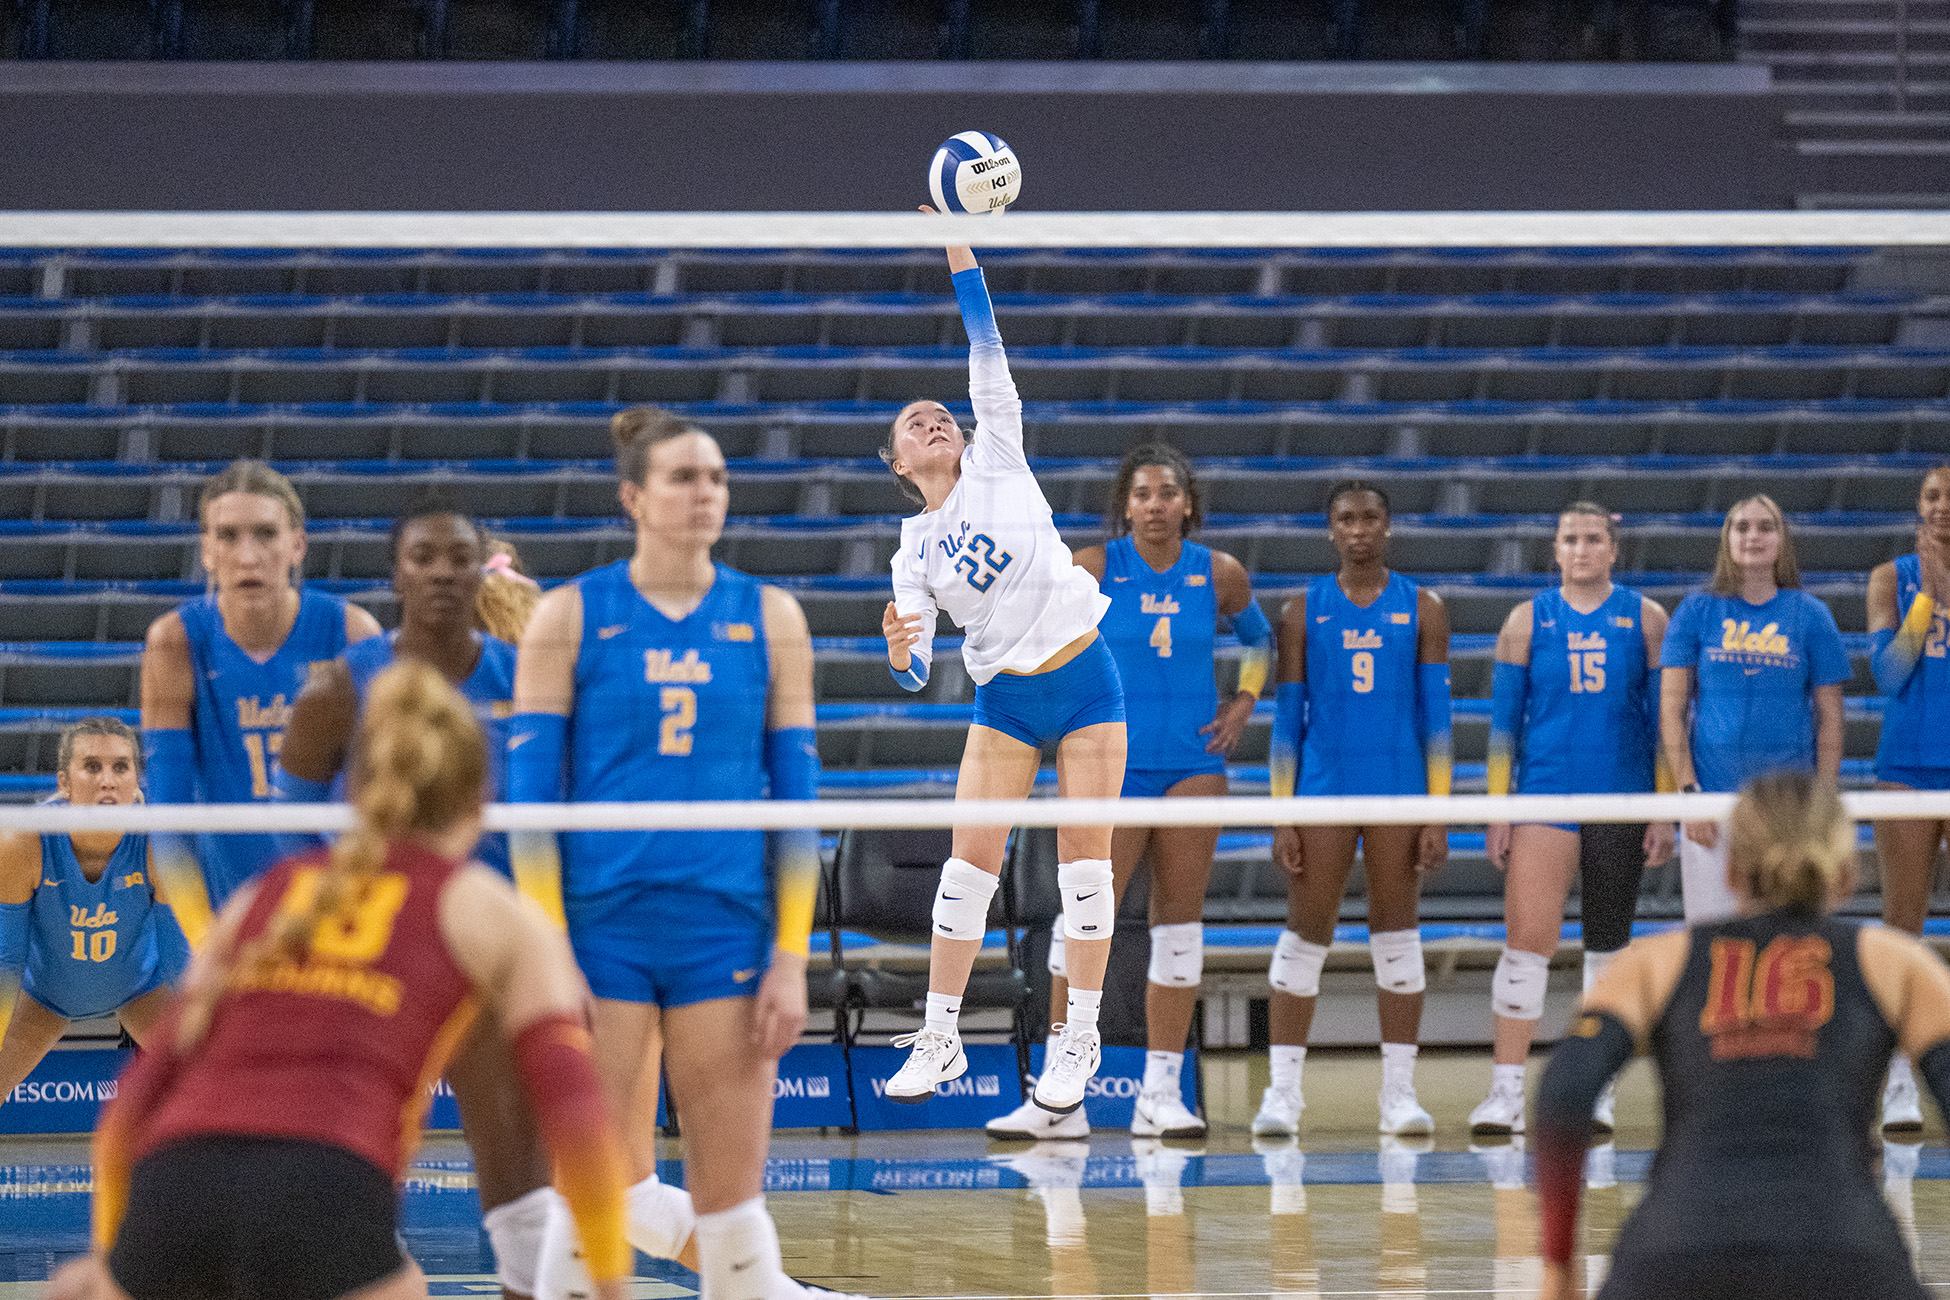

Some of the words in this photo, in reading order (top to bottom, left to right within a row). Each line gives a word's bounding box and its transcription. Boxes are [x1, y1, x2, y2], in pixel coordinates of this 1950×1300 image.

[971, 156, 1011, 175] Wilson
[954, 532, 1014, 595] 22
[1149, 616, 1172, 658] 4
[1352, 651, 1375, 693] 9
[1567, 651, 1607, 694] 15
[658, 686, 698, 757] 2
[243, 734, 286, 797] 1
[70, 929, 117, 963] 10
[1700, 935, 1835, 1034] 16
